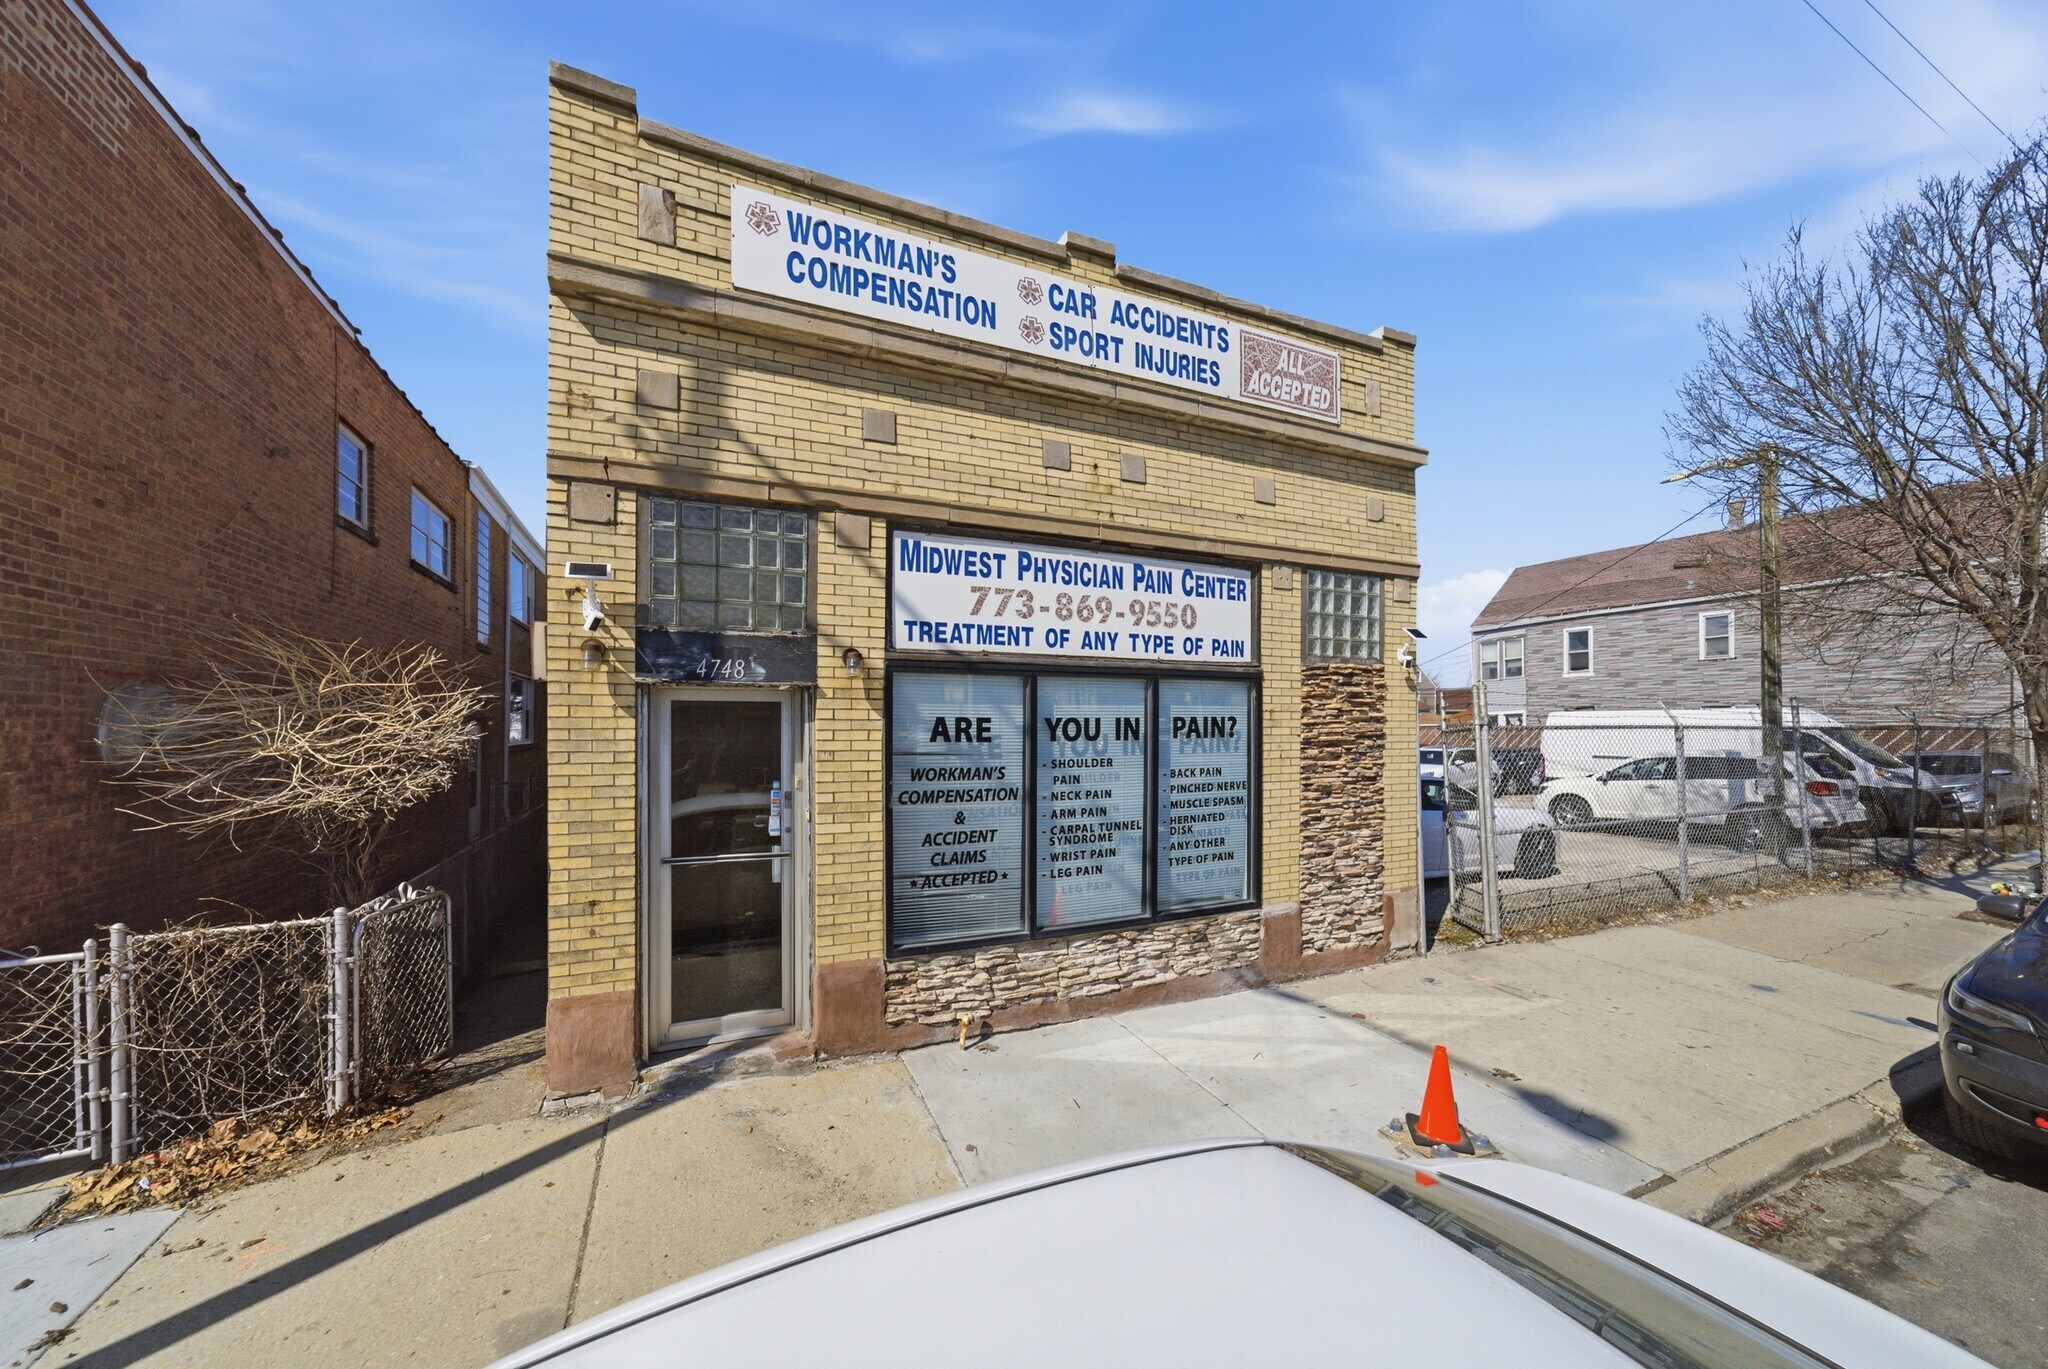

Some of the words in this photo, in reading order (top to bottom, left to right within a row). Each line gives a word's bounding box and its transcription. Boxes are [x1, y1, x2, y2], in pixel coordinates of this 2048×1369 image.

[786, 210, 957, 284] WORKMAN'S
[786, 250, 997, 330] COMPENSATION
[1049, 283, 1097, 320] CAR
[1110, 300, 1230, 353] ACCIDENTS
[1049, 322, 1124, 363] SPORT
[1135, 341, 1221, 387] INJURIES
[1276, 347, 1306, 376] ALL
[1247, 369, 1331, 410] ACCEPTED
[900, 538, 1006, 579] MIDWEST
[1017, 550, 1124, 590] PHYSICIAN
[1133, 563, 1173, 595] PAIN
[1181, 568, 1248, 602] CENTER
[969, 585, 1198, 630] 773-869-9550
[903, 620, 1034, 647] TREATMENT
[1045, 628, 1070, 648] OF
[1081, 630, 1119, 651] ANY
[1128, 633, 1174, 654] TYPE
[1182, 636, 1204, 656] OF
[1212, 638, 1245, 658] PAIN
[696, 659, 745, 679] 4748
[929, 716, 992, 743] ARE
[1045, 717, 1101, 742] YOU
[1115, 717, 1141, 741] IN
[1172, 716, 1237, 739] PAIN?
[1051, 758, 1114, 769] SHOULDER
[911, 766, 1006, 782] WORKMAN'S
[1053, 775, 1081, 786] PAIN
[1170, 768, 1197, 778] BACK
[1199, 767, 1222, 777] PAIN
[1051, 791, 1082, 801] NECK
[1085, 789, 1112, 800] PAIN
[1170, 783, 1214, 794] PINCHED
[1216, 780, 1247, 792] NERVE
[898, 787, 1019, 805] COMPENSATION
[1170, 798, 1210, 810] MUSCLE
[1212, 796, 1245, 807] SPASM
[954, 811, 966, 825] &
[1050, 809, 1077, 820] ARM
[1081, 806, 1107, 818] PAIN
[1170, 812, 1226, 826] HERNIATED
[1050, 823, 1095, 836] CARPAL
[1098, 820, 1142, 833] TUNNEL
[1170, 824, 1194, 836] DISK
[922, 829, 998, 847] ACCIDENT
[1049, 832, 1114, 847] SYNDROME
[1169, 840, 1191, 852] ANY
[1193, 837, 1226, 849] OTHER
[930, 850, 987, 867] CLAIMS
[1050, 850, 1087, 863] WRIST
[1090, 848, 1117, 860] PAIN
[1168, 856, 1193, 868] TYPE
[1195, 853, 1209, 865] OF
[1211, 851, 1235, 863] PAIN
[921, 870, 998, 890] ACCEPTED
[1050, 868, 1072, 879] LEG
[1076, 865, 1103, 877] PAIN
